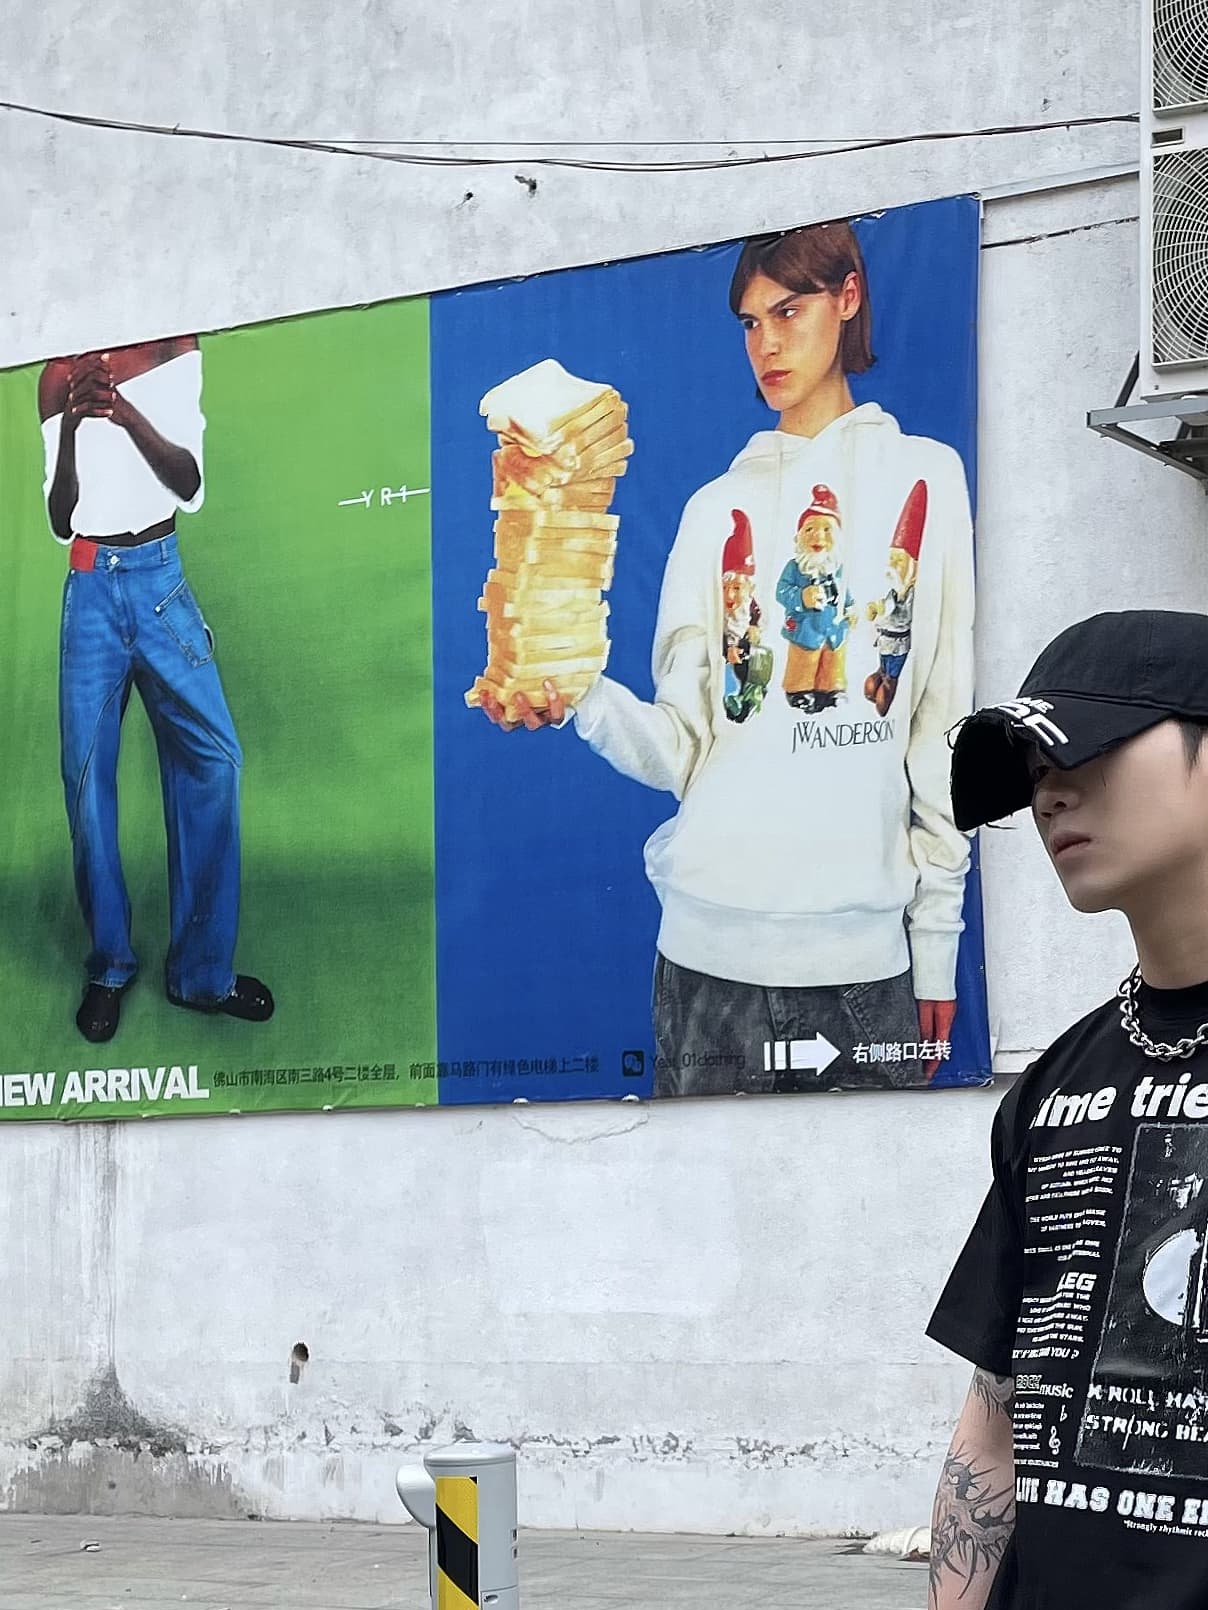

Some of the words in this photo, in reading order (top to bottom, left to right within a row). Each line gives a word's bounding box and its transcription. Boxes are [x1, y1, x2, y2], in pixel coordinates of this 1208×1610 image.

[852, 1039, 953, 1064] 右侧路口左转
[0, 1072, 56, 1107] EW
[60, 1065, 210, 1104] ARRIVAL
[1029, 1087, 1117, 1130] ime
[1043, 1479, 1110, 1512] HAS
[1116, 1489, 1176, 1521] ONE
